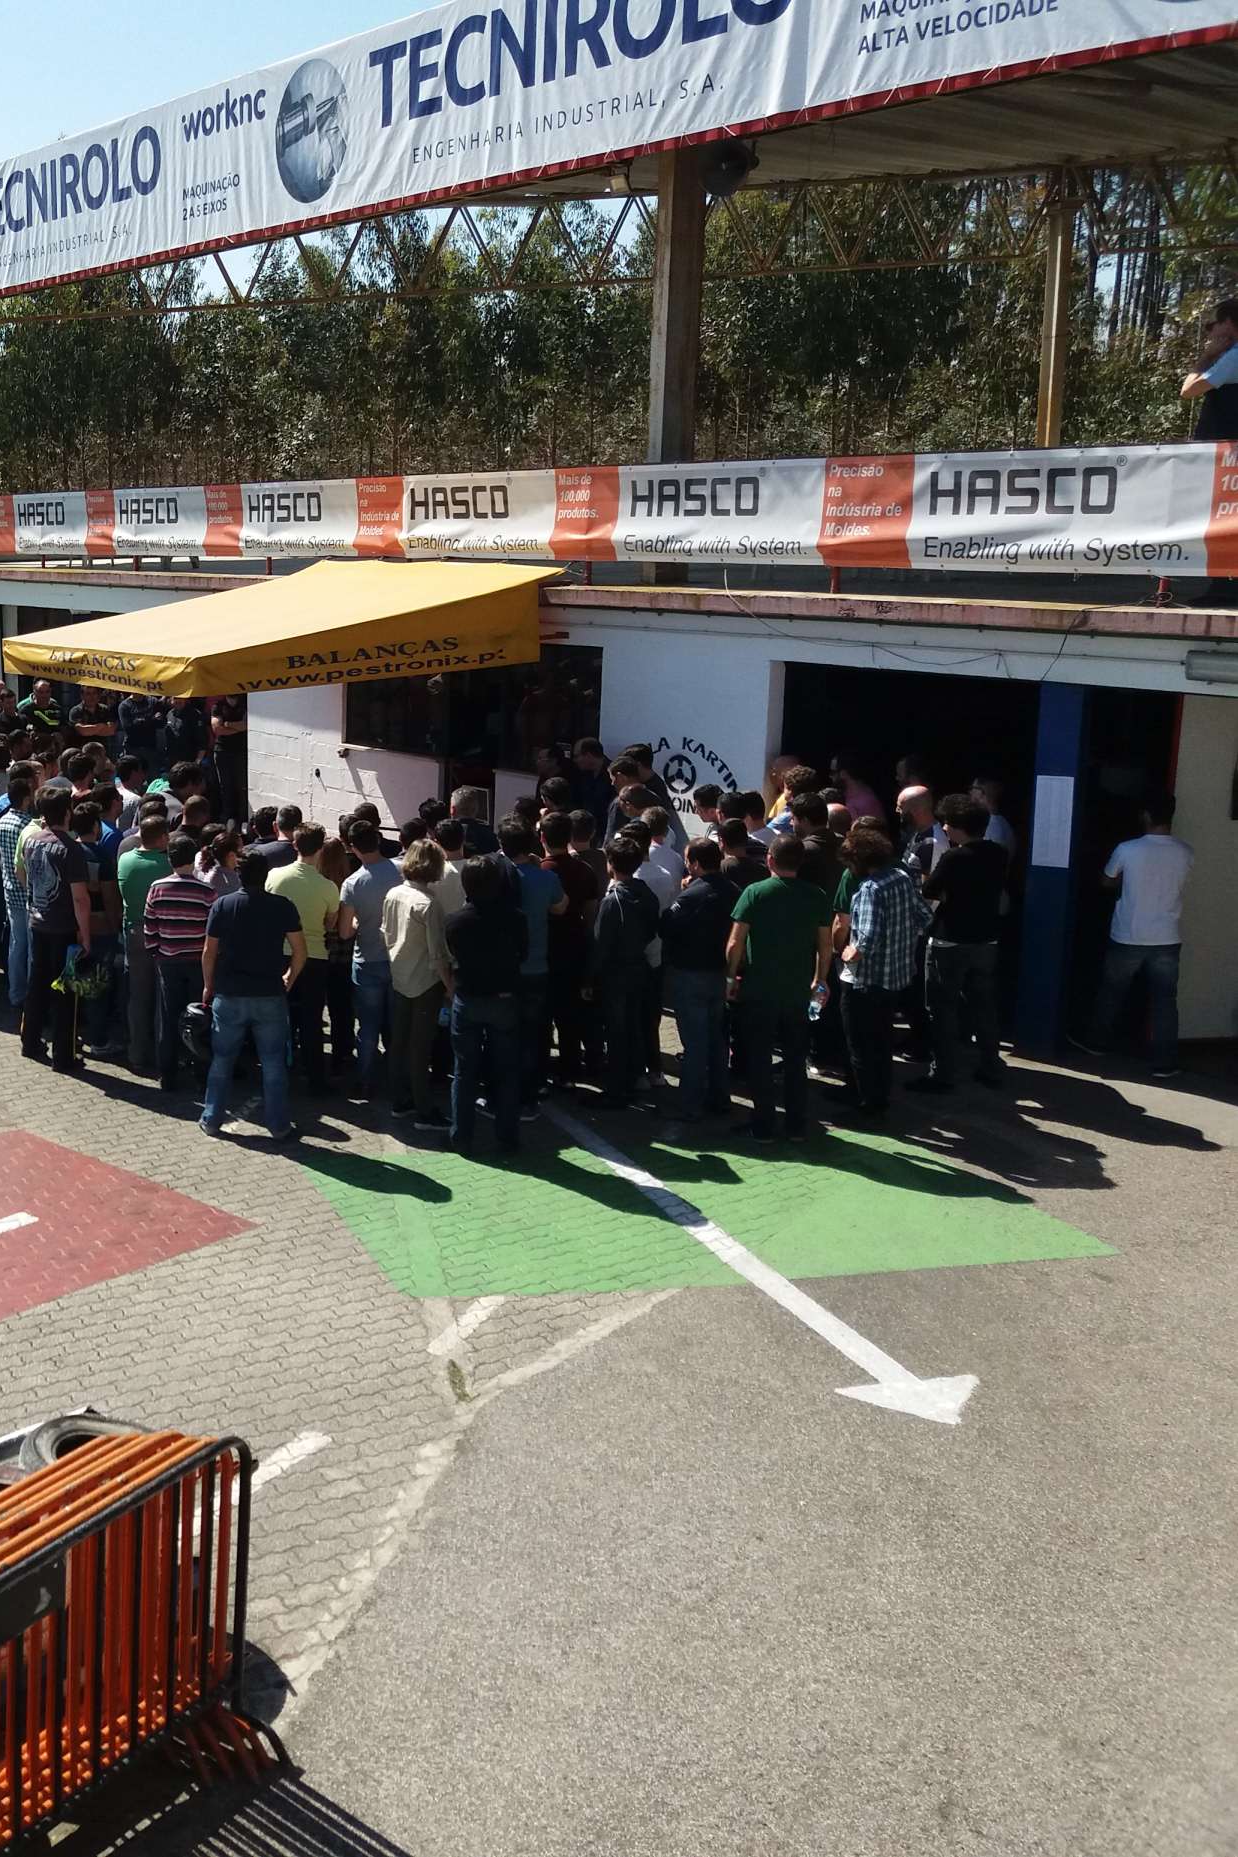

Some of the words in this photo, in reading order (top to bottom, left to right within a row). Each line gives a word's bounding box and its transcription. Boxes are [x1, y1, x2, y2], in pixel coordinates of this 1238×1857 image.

[858, 26, 909, 55] ALTA
[916, 0, 1059, 41] VELOCIDADE
[369, 0, 792, 128] TECNIRO
[413, 121, 523, 164] ENGENHARIA
[535, 89, 666, 134] INDUSTRIAL,
[680, 73, 724, 99] S.A.
[182, 172, 240, 200] MAQUINAÇÃO
[203, 198, 227, 216] EIXOS
[558, 473, 577, 486] Mais
[579, 474, 592, 485] de
[829, 464, 883, 479] Precisão
[410, 485, 509, 520] HASCO
[630, 476, 760, 517] HASCO
[827, 486, 842, 498] na
[929, 466, 1117, 516] HASCO
[17, 502, 65, 526] HASCO
[119, 498, 178, 524] HASCO
[248, 492, 322, 523] HASCO
[390, 511, 400, 521] de
[557, 507, 599, 521] produtos.
[825, 502, 882, 517] Indústria
[886, 502, 902, 516] de
[408, 533, 459, 551] Enabling
[461, 535, 487, 550] with
[824, 522, 871, 537] Moldes.
[624, 534, 692, 556] Enabling
[698, 535, 730, 555] with
[736, 535, 808, 558] System.
[924, 536, 1018, 565] Enabling
[1029, 537, 1074, 560] with
[1083, 537, 1189, 568] System.
[286, 636, 459, 670] BALANÇAS
[682, 736, 738, 793] KARTIN
